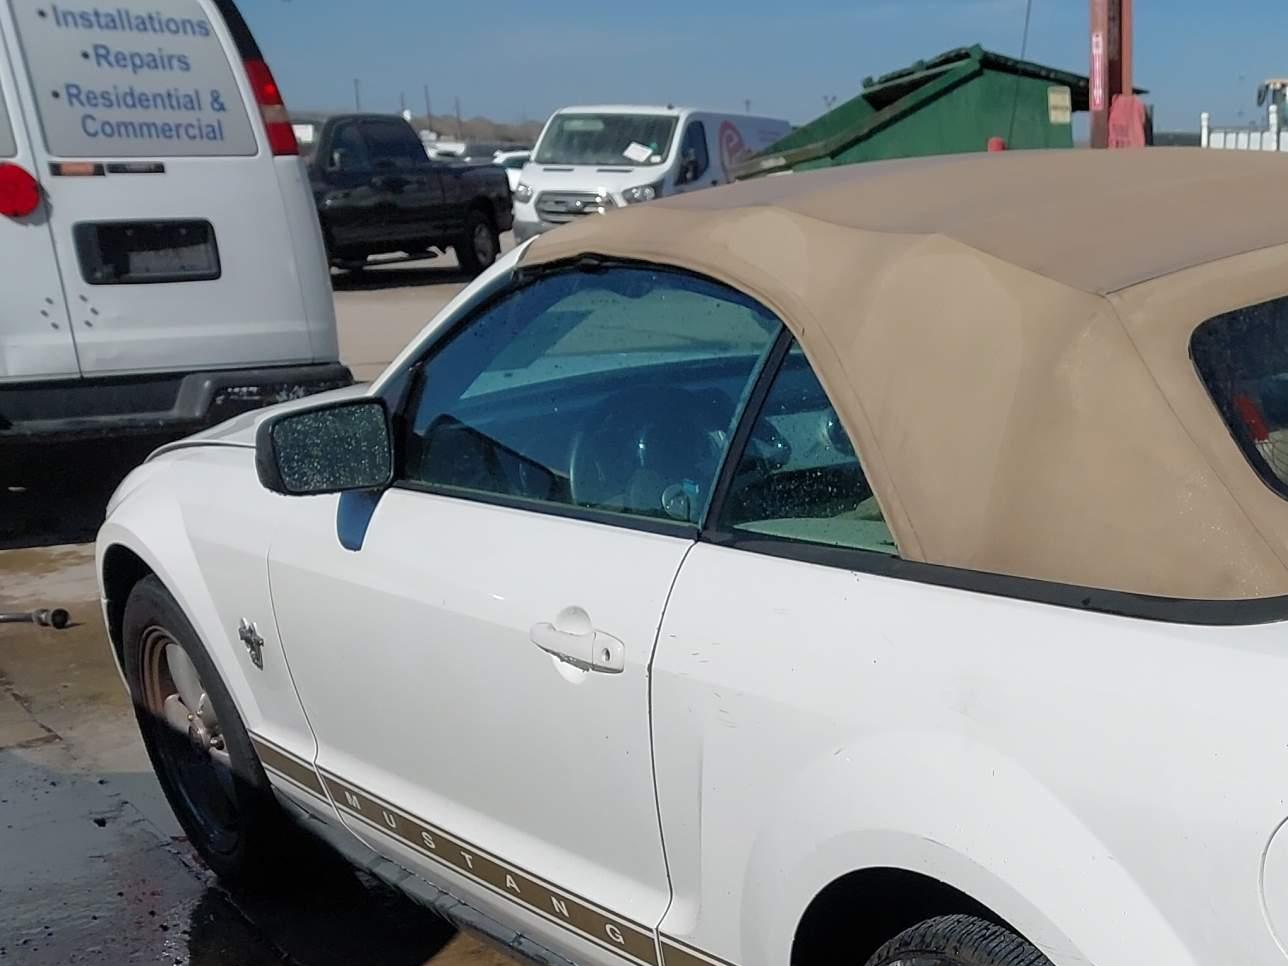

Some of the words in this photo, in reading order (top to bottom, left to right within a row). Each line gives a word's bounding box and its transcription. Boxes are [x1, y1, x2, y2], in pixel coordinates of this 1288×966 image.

[52, 5, 210, 37] Installations
[93, 44, 191, 74] Repairs
[65, 84, 202, 112] Residential
[209, 89, 226, 112] &
[81, 114, 224, 141] Commercial
[344, 791, 625, 945] MUSTANG
